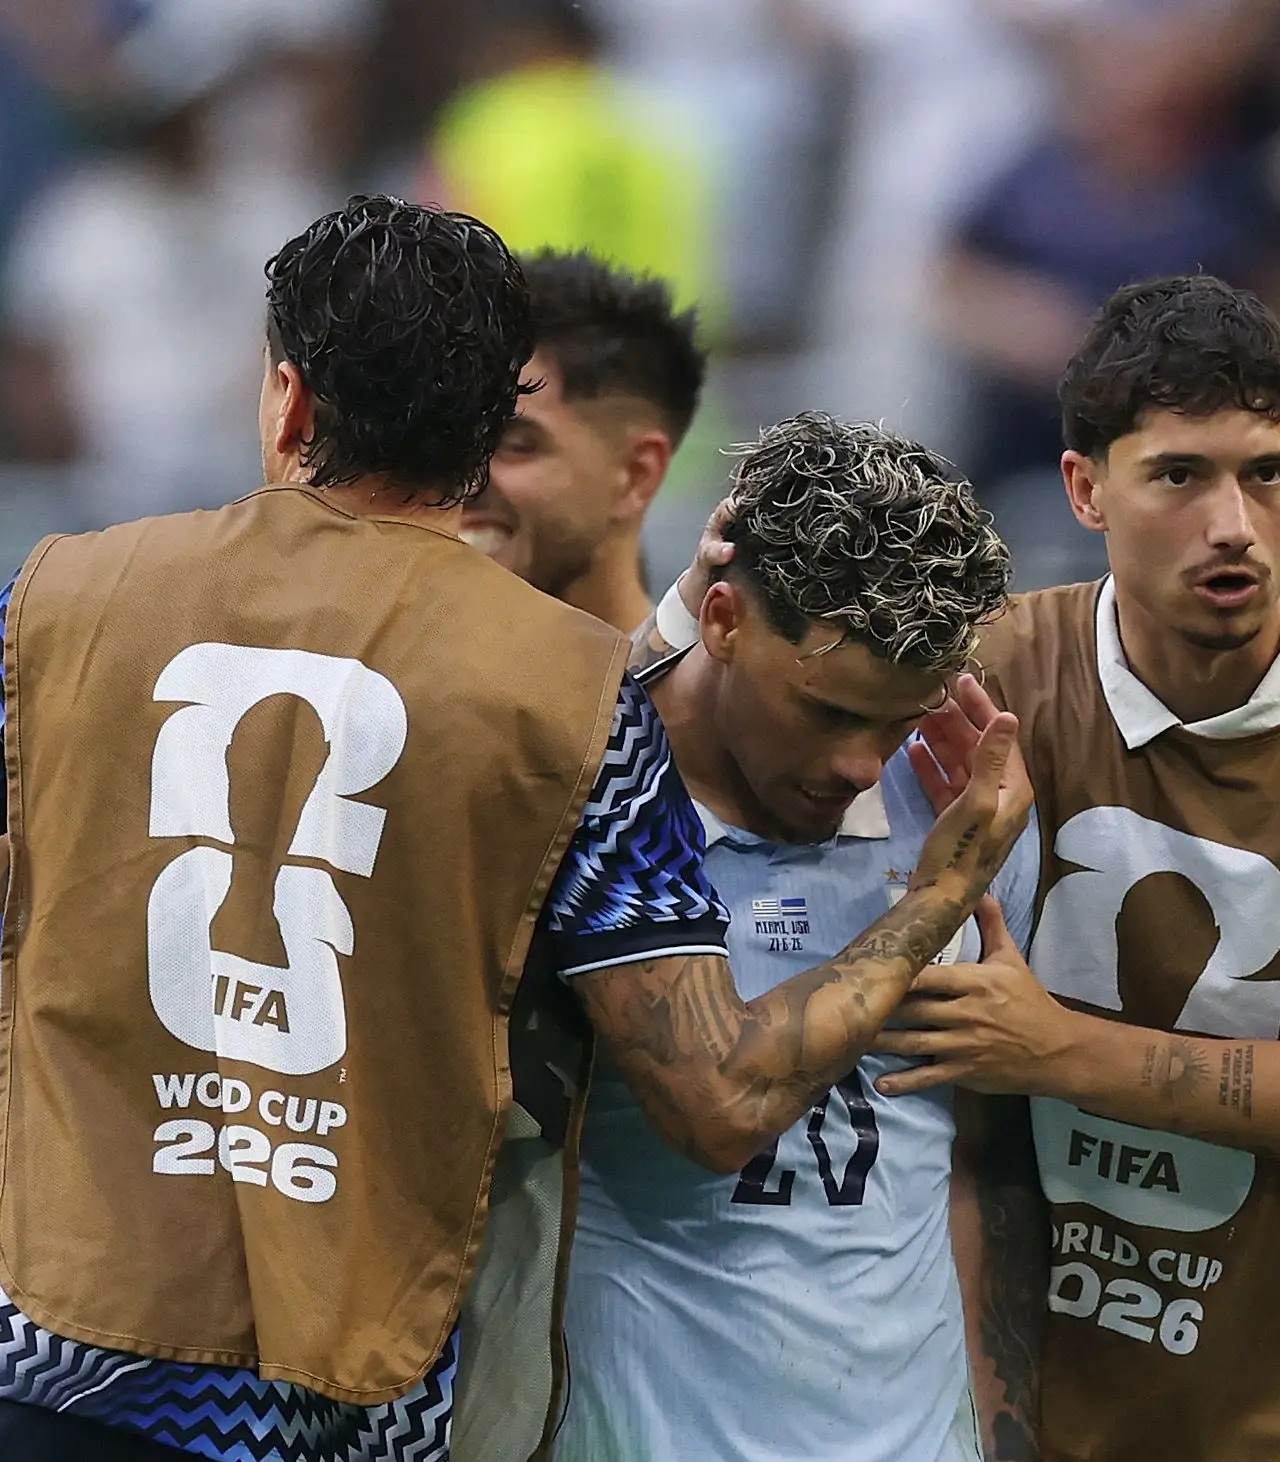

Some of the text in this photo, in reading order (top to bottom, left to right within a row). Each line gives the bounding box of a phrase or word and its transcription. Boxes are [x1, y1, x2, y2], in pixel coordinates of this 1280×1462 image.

[791, 920, 810, 935] USA
[211, 974, 291, 1034] IFA
[258, 1089, 348, 1136] CUP
[1068, 1129, 1180, 1193] FIFA
[1051, 1221, 1223, 1292] RLD CUP
[1047, 1261, 1205, 1356] 026
